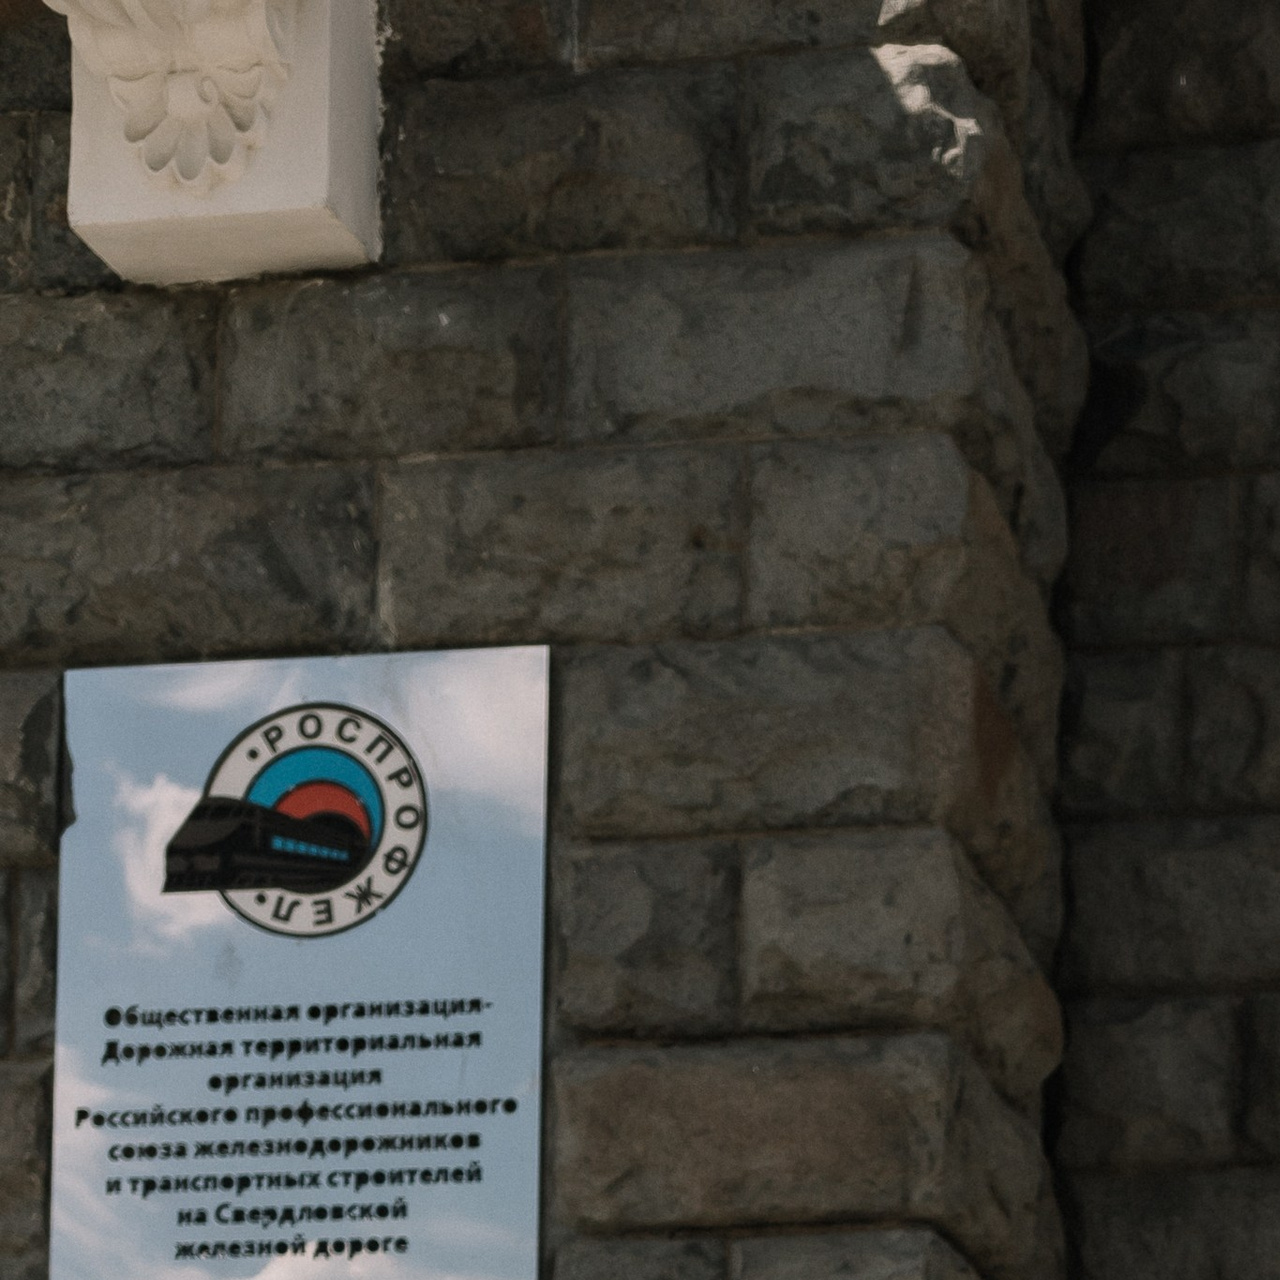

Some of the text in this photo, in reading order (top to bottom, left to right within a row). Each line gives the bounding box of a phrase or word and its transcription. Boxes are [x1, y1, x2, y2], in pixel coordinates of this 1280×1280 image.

[262, 713, 421, 925] РОСПРОФЖЕЛ
[104, 1004, 300, 1029] Общественная
[101, 1032, 481, 1066] Дорожная территориальная
[208, 1069, 382, 1096] организация
[75, 1098, 517, 1129] Российского профессионального
[108, 1134, 481, 1161] союза железнодорожников
[106, 1161, 481, 1198] и транспортных строителей
[178, 1197, 407, 1228] на Свердловской
[175, 1233, 408, 1260] железной дороге
